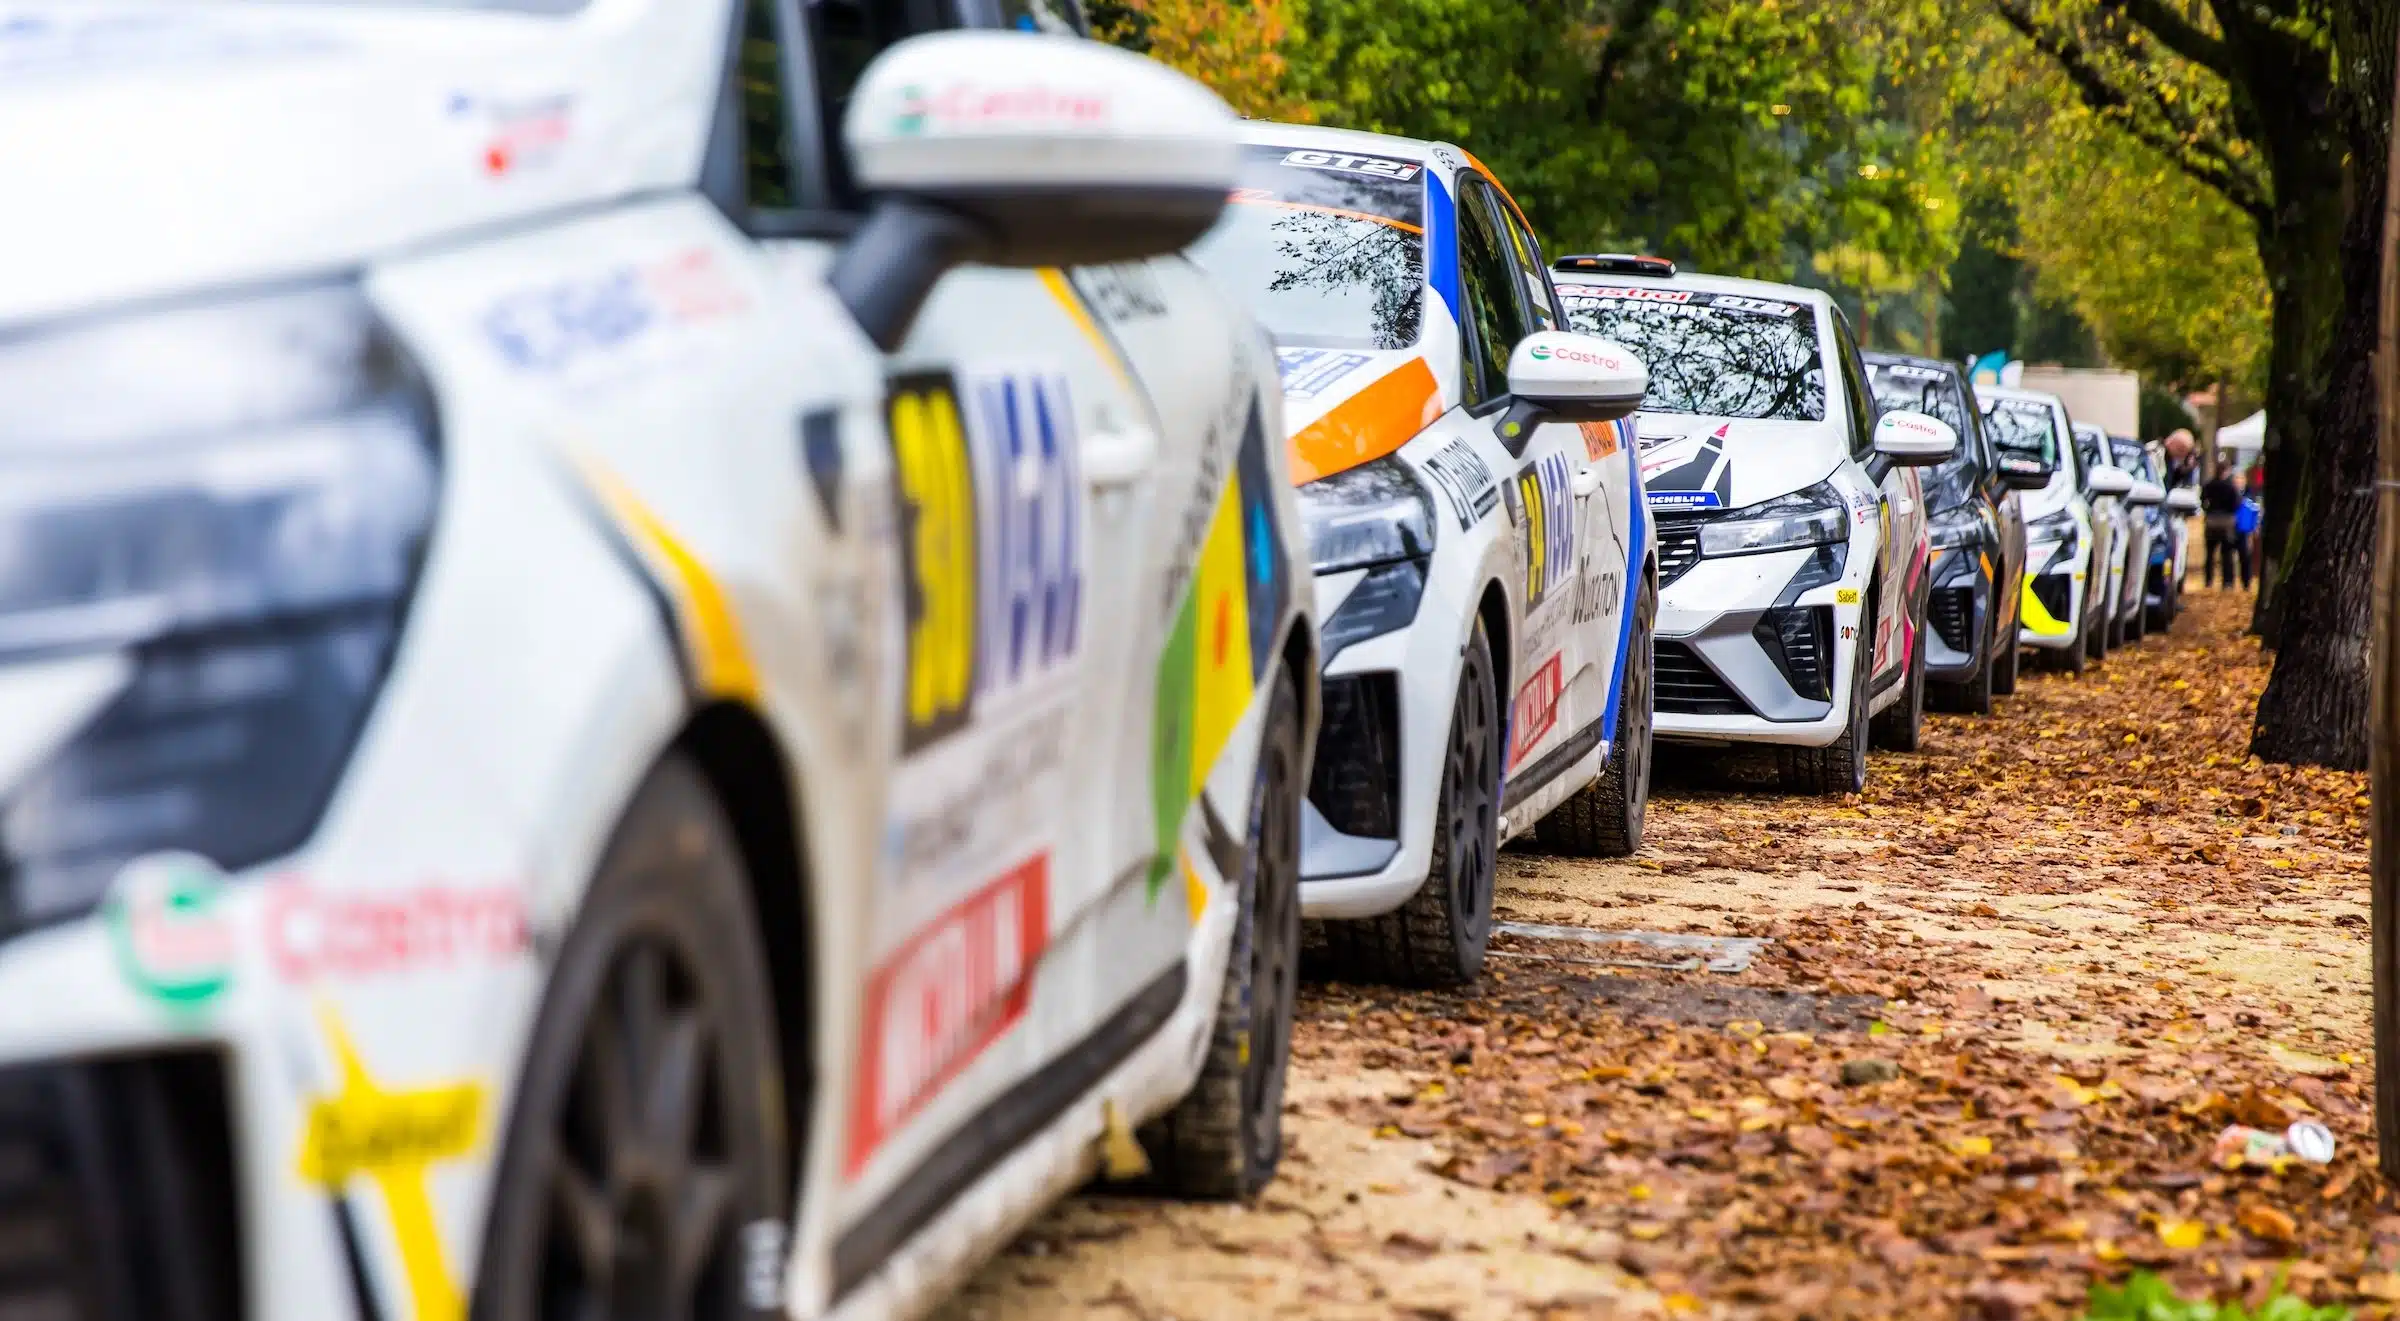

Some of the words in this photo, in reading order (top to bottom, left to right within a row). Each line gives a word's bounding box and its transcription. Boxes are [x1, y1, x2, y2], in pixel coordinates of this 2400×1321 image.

[1287, 150, 1419, 180] GT2i
[1553, 284, 1692, 304] Castrol
[1622, 299, 1717, 319] SPORT
[1555, 348, 1620, 371] Castrol
[1897, 419, 1938, 436] Castrol
